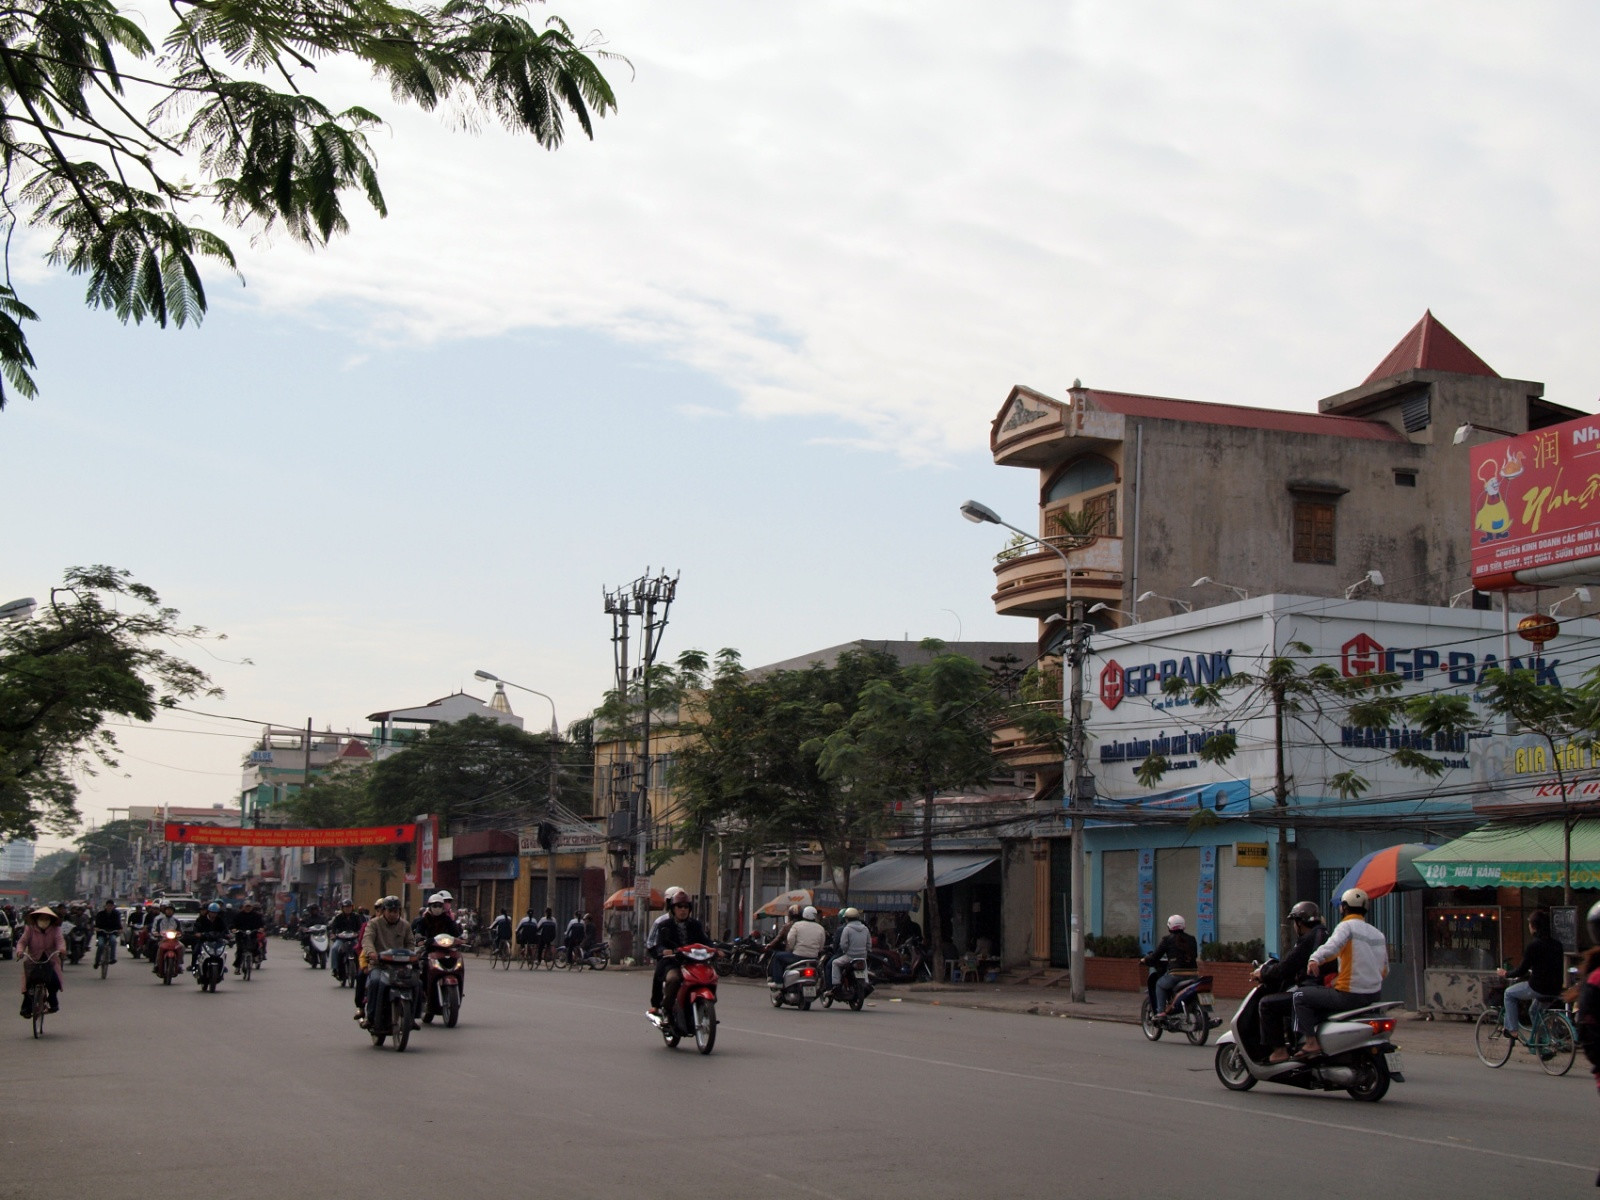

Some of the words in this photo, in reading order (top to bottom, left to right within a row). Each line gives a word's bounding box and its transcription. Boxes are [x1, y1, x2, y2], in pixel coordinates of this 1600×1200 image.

[1533, 430, 1559, 469] 润
[1521, 466, 1600, 534] Nhuậ
[1515, 746, 1546, 774] BIA
[1425, 864, 1447, 879] 120
